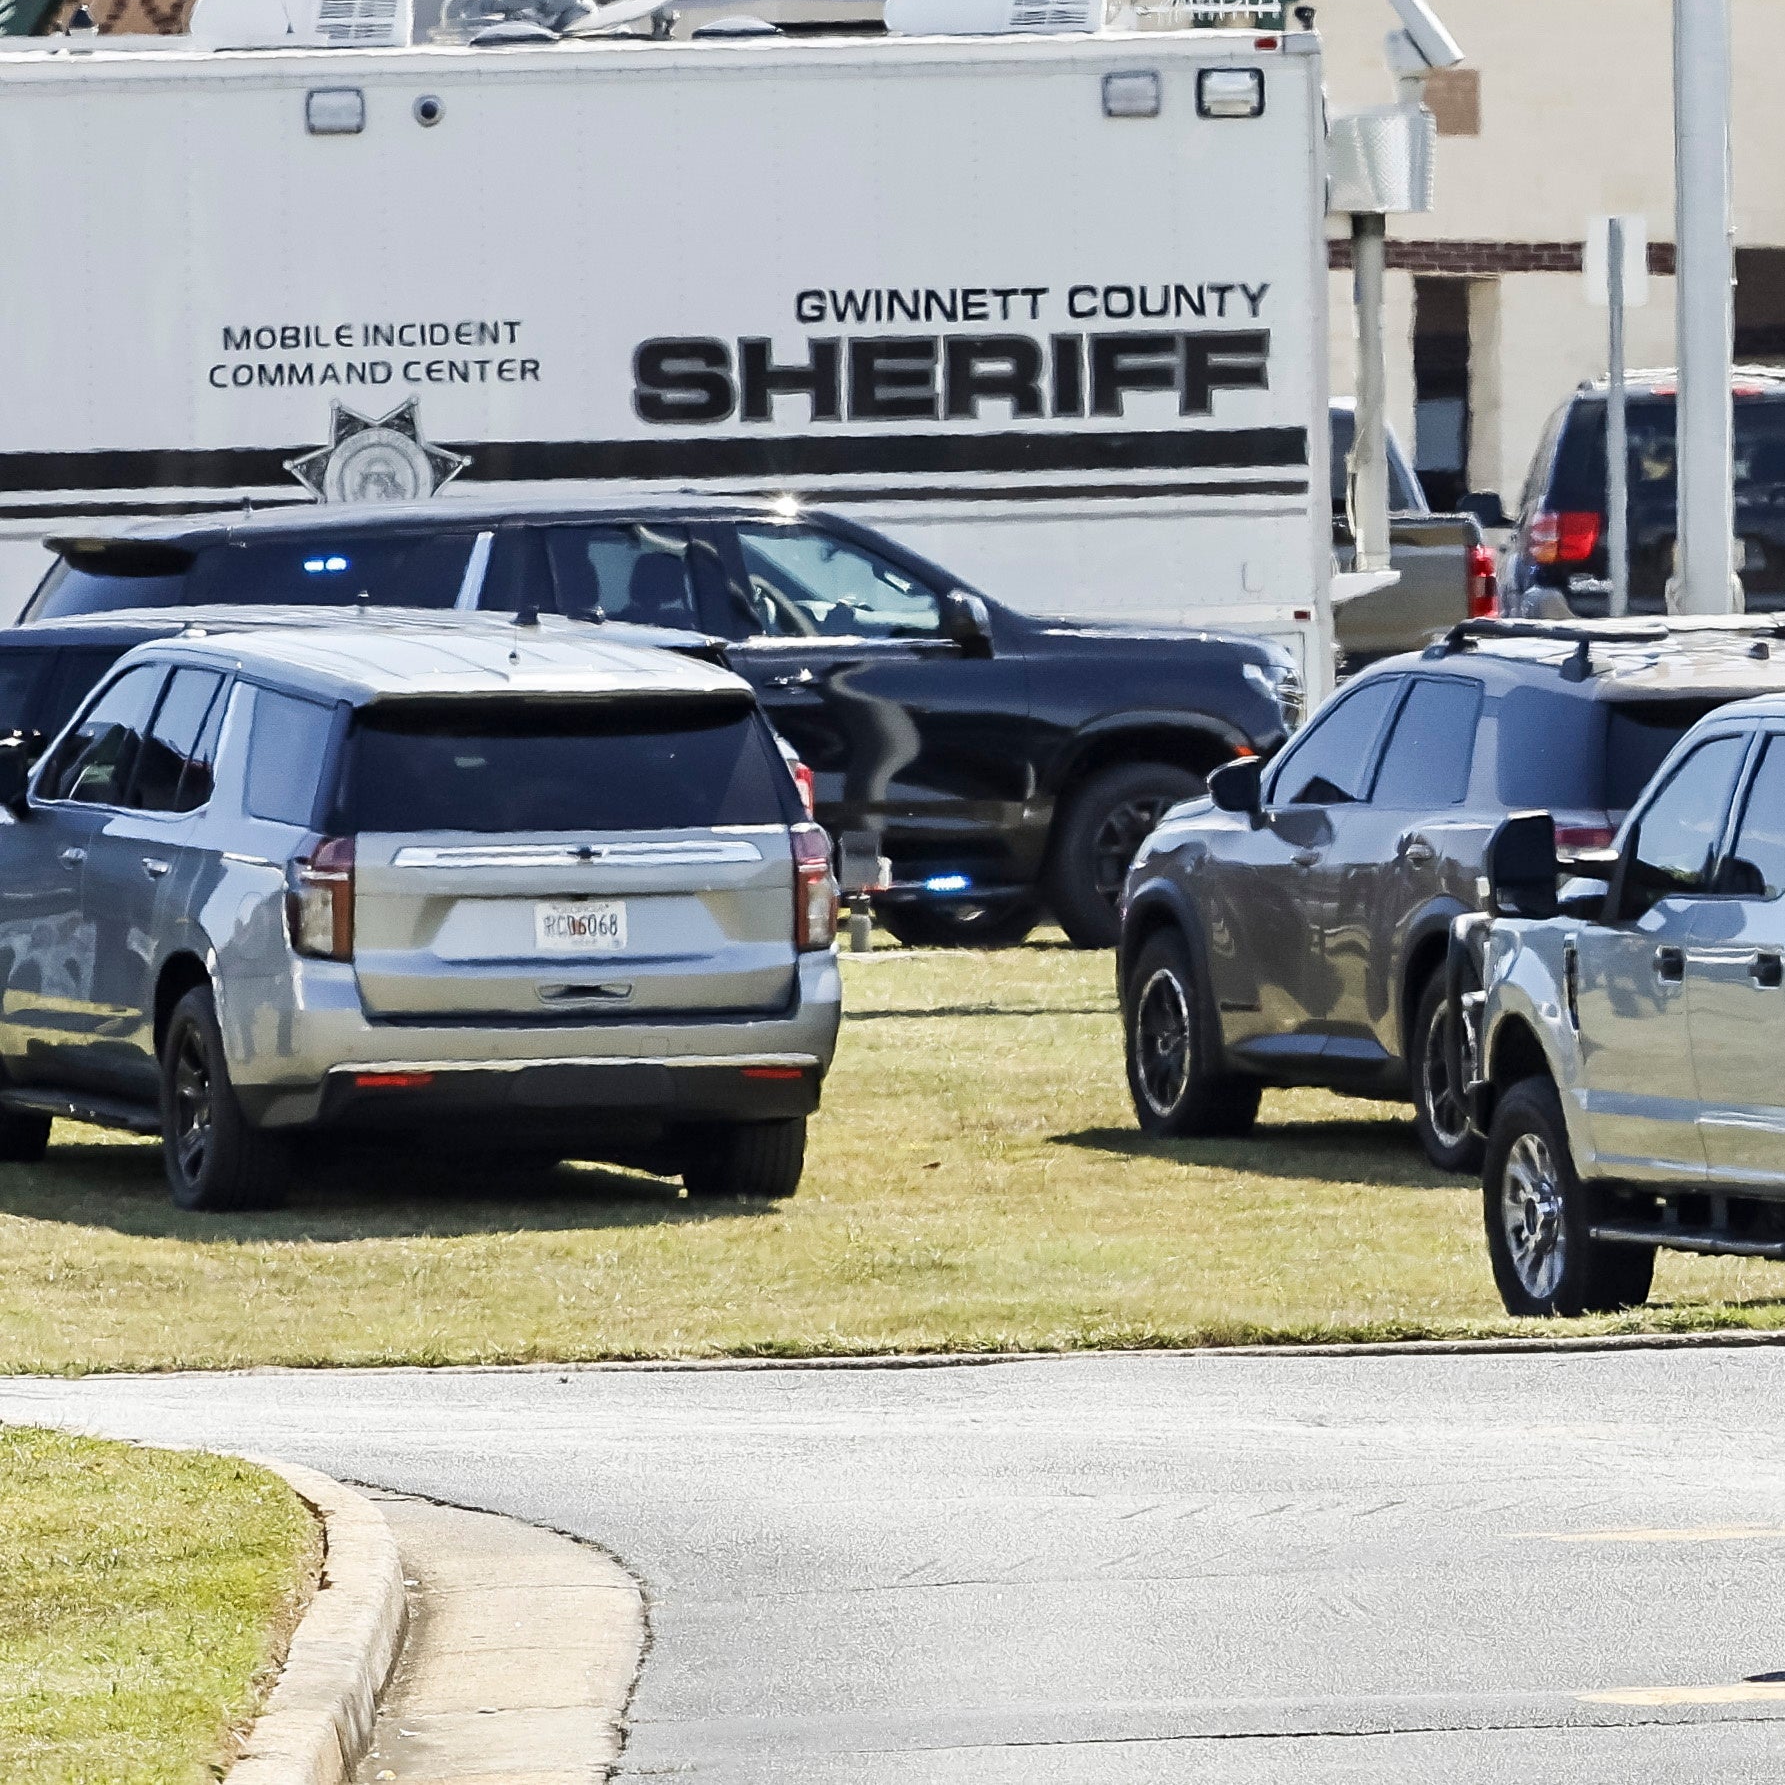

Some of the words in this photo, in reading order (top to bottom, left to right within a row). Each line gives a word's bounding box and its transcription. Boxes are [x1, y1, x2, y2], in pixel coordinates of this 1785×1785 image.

[796, 286, 1050, 323] GWINNETT
[1066, 282, 1271, 320] COUNTY
[221, 322, 354, 352] MOBILE
[362, 319, 523, 348] INCIDENT
[208, 360, 393, 389] COMMAND
[402, 357, 541, 385] CENTER
[631, 327, 1272, 426] SHERIFF
